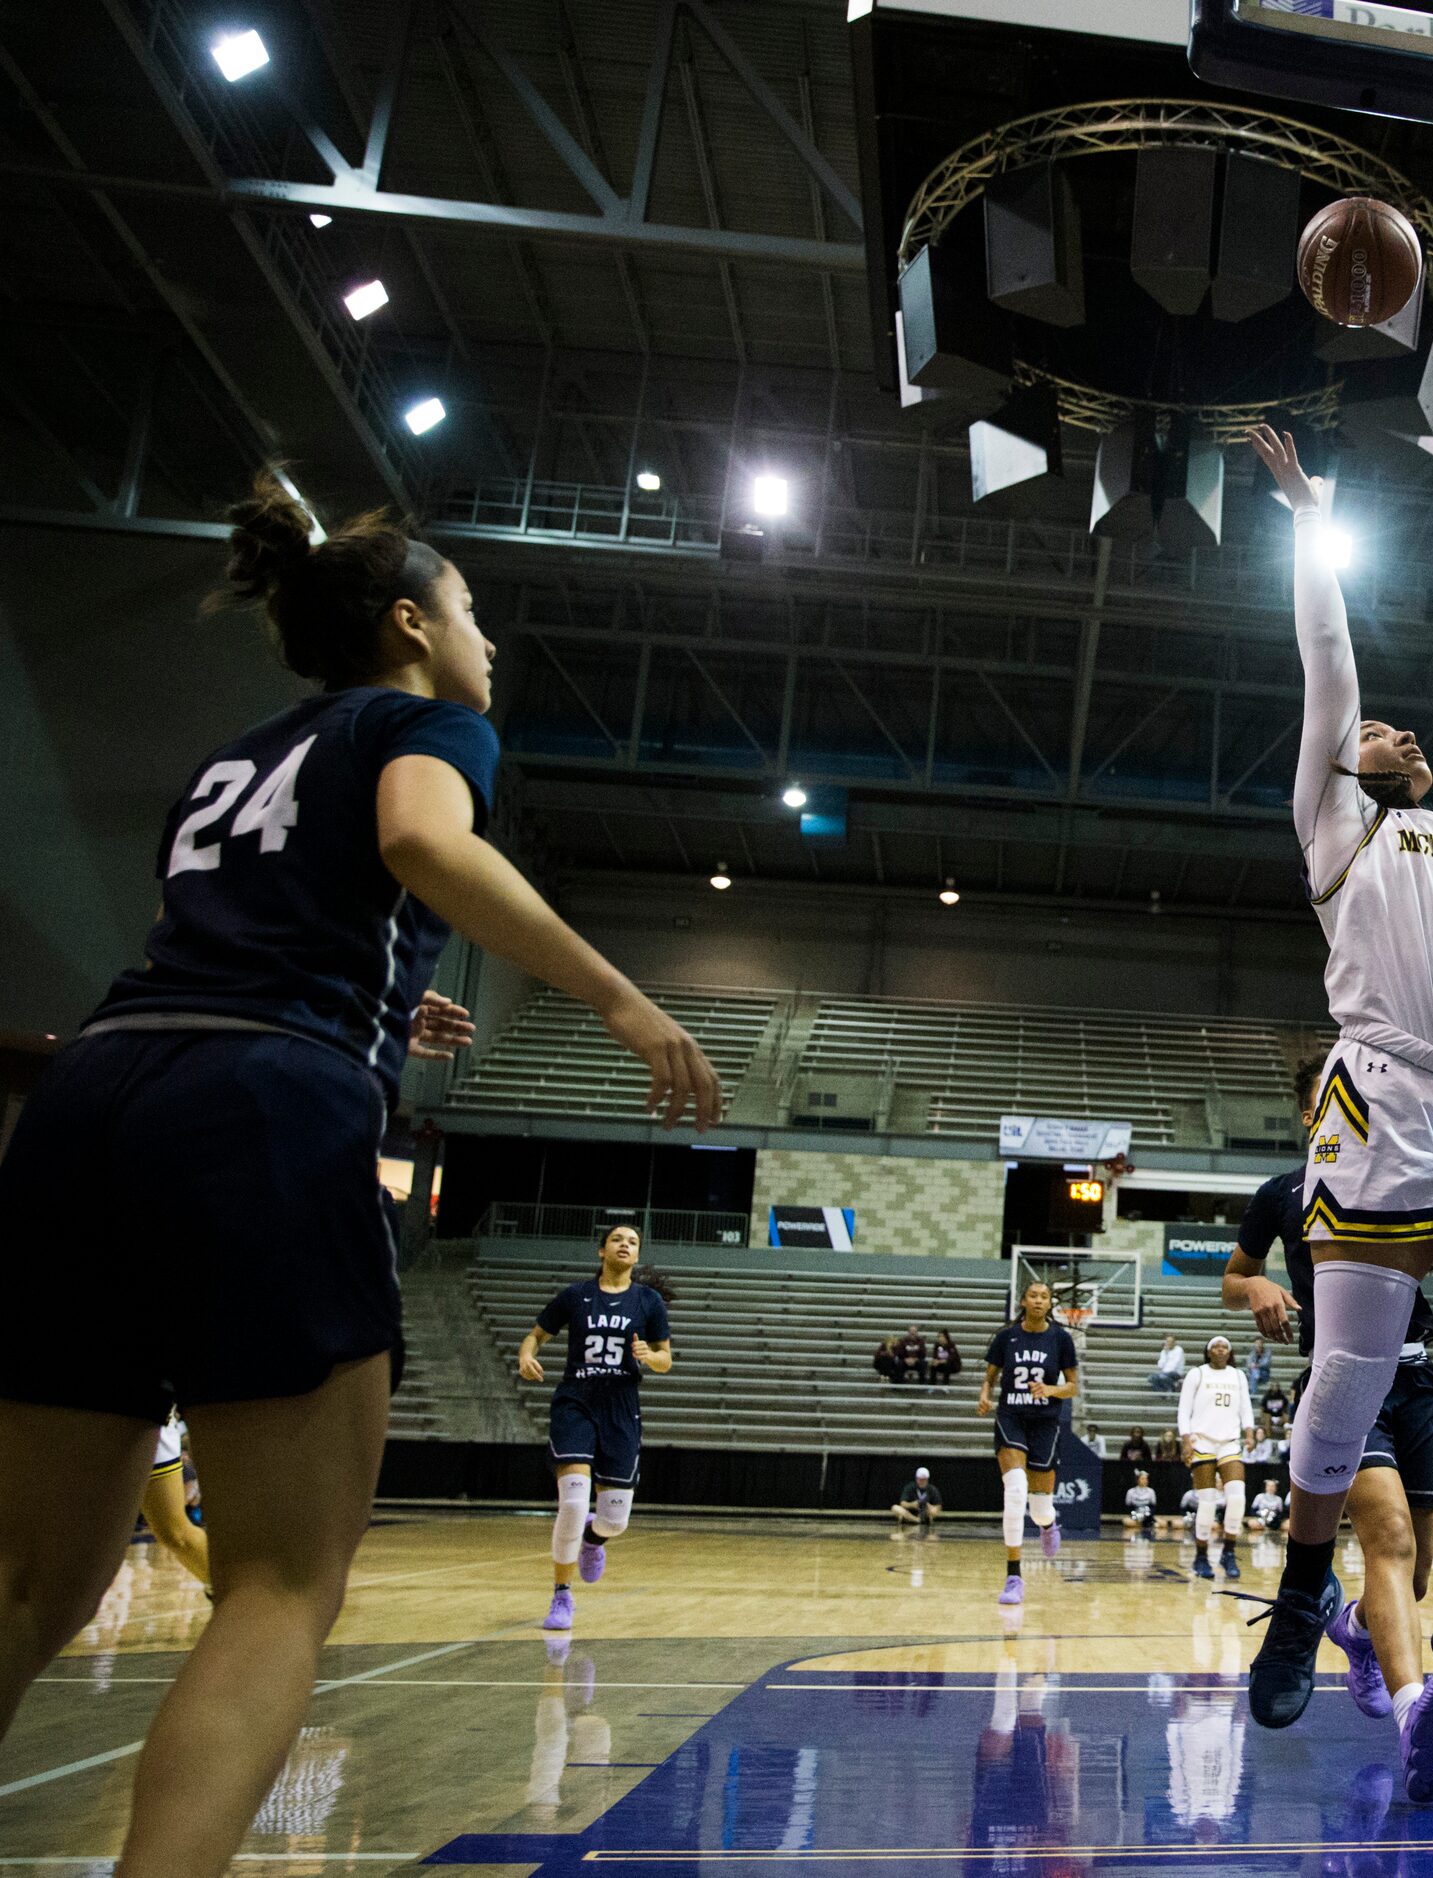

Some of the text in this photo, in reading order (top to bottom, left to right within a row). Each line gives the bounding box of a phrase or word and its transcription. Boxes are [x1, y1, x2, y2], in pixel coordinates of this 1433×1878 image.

[167, 733, 318, 879] 24
[1315, 1145, 1340, 1153] LIONS
[1070, 1183, 1102, 1201] 1:50
[587, 1315, 632, 1331] LADY
[584, 1335, 625, 1366] 25
[1014, 1350, 1048, 1364] LADY
[1215, 1392, 1231, 1407] 20
